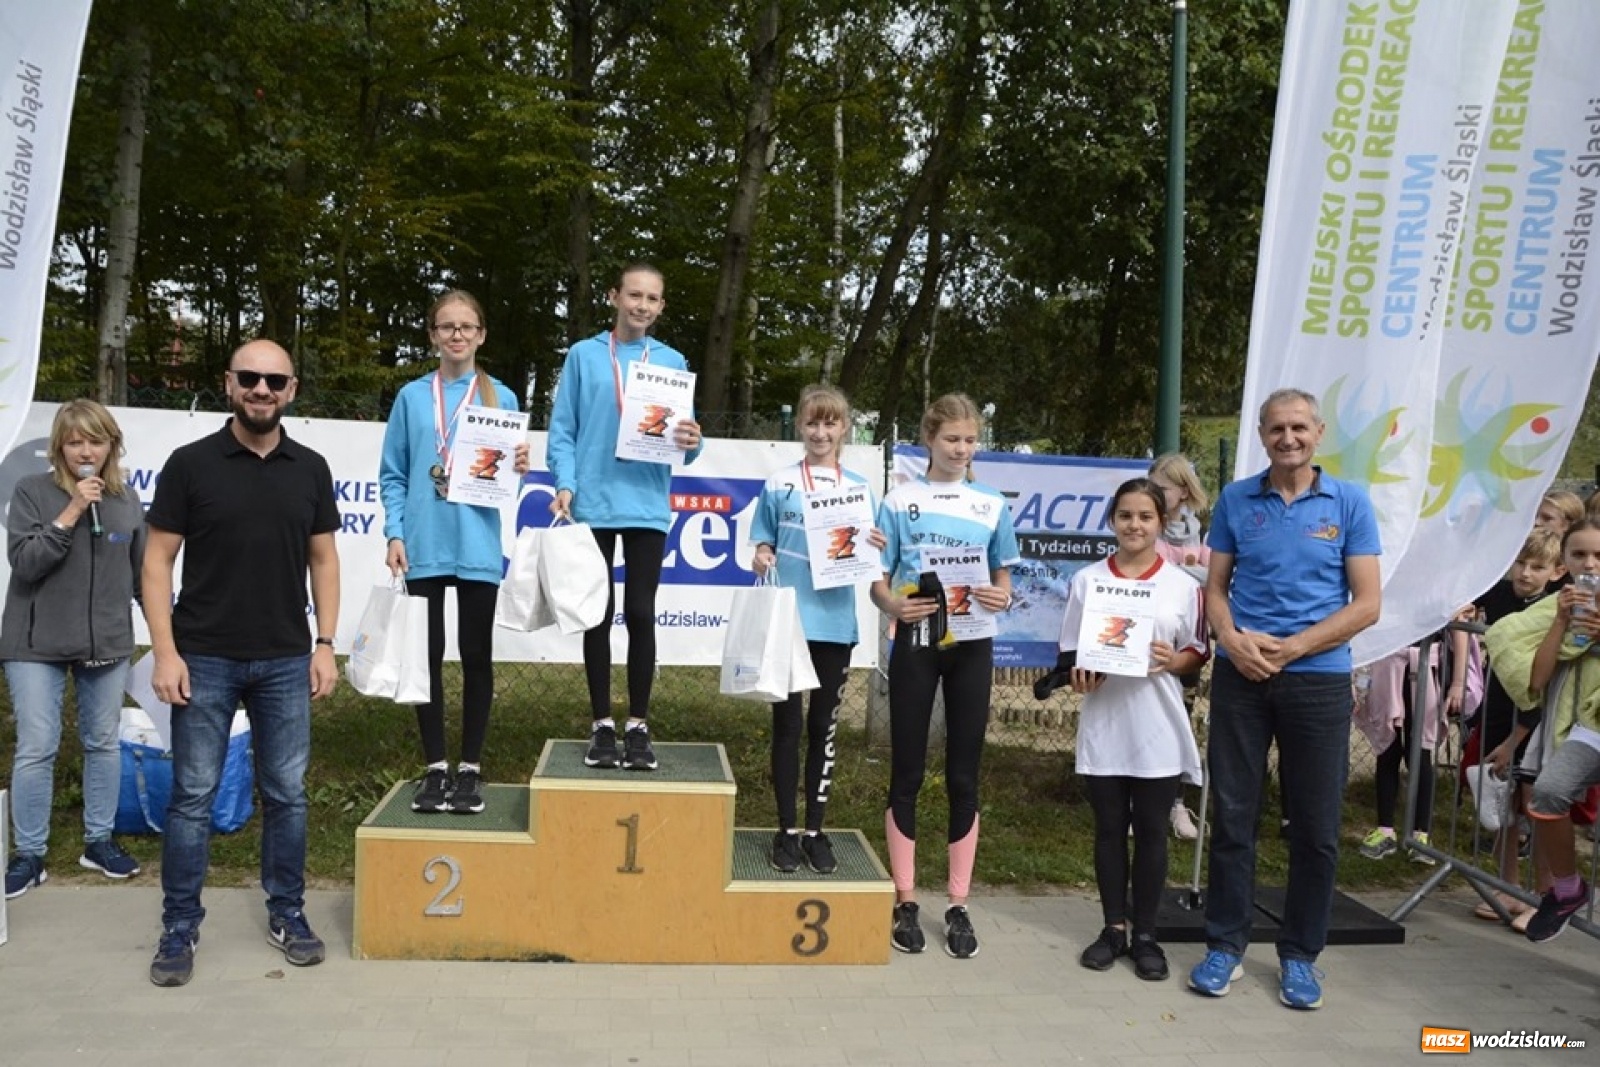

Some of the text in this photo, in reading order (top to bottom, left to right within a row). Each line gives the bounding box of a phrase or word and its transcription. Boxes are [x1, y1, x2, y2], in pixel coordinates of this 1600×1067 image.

[9, 59, 43, 134] Śląski
[1440, 103, 1483, 184] Śląski
[1301, 2, 1379, 336] MIEJSKI OŚRODEK
[1359, 170, 1391, 181] I
[1461, 0, 1545, 333] SPORTU I REKREA
[1380, 153, 1439, 339] CENTRUM
[1504, 147, 1567, 336] CENTRUM
[1337, 191, 1387, 338] SPORTU
[1548, 186, 1598, 336] Wodzisław
[636, 371, 689, 389] DYPLOM
[467, 414, 521, 430] DYPLOM
[334, 480, 377, 502] KIE
[674, 496, 724, 510] WSKA
[784, 483, 795, 500] 7
[811, 494, 865, 509] DYPLOM
[341, 512, 375, 534] RY
[908, 503, 920, 522] 8
[1012, 493, 1115, 531] ACTI
[929, 554, 981, 566] DYPLOM
[1028, 539, 1092, 556] Tydzień
[1096, 541, 1119, 556] Sp
[1096, 585, 1151, 598] DYPLOM
[615, 813, 644, 874] 1
[423, 855, 465, 917] 2
[790, 900, 831, 956] 3
